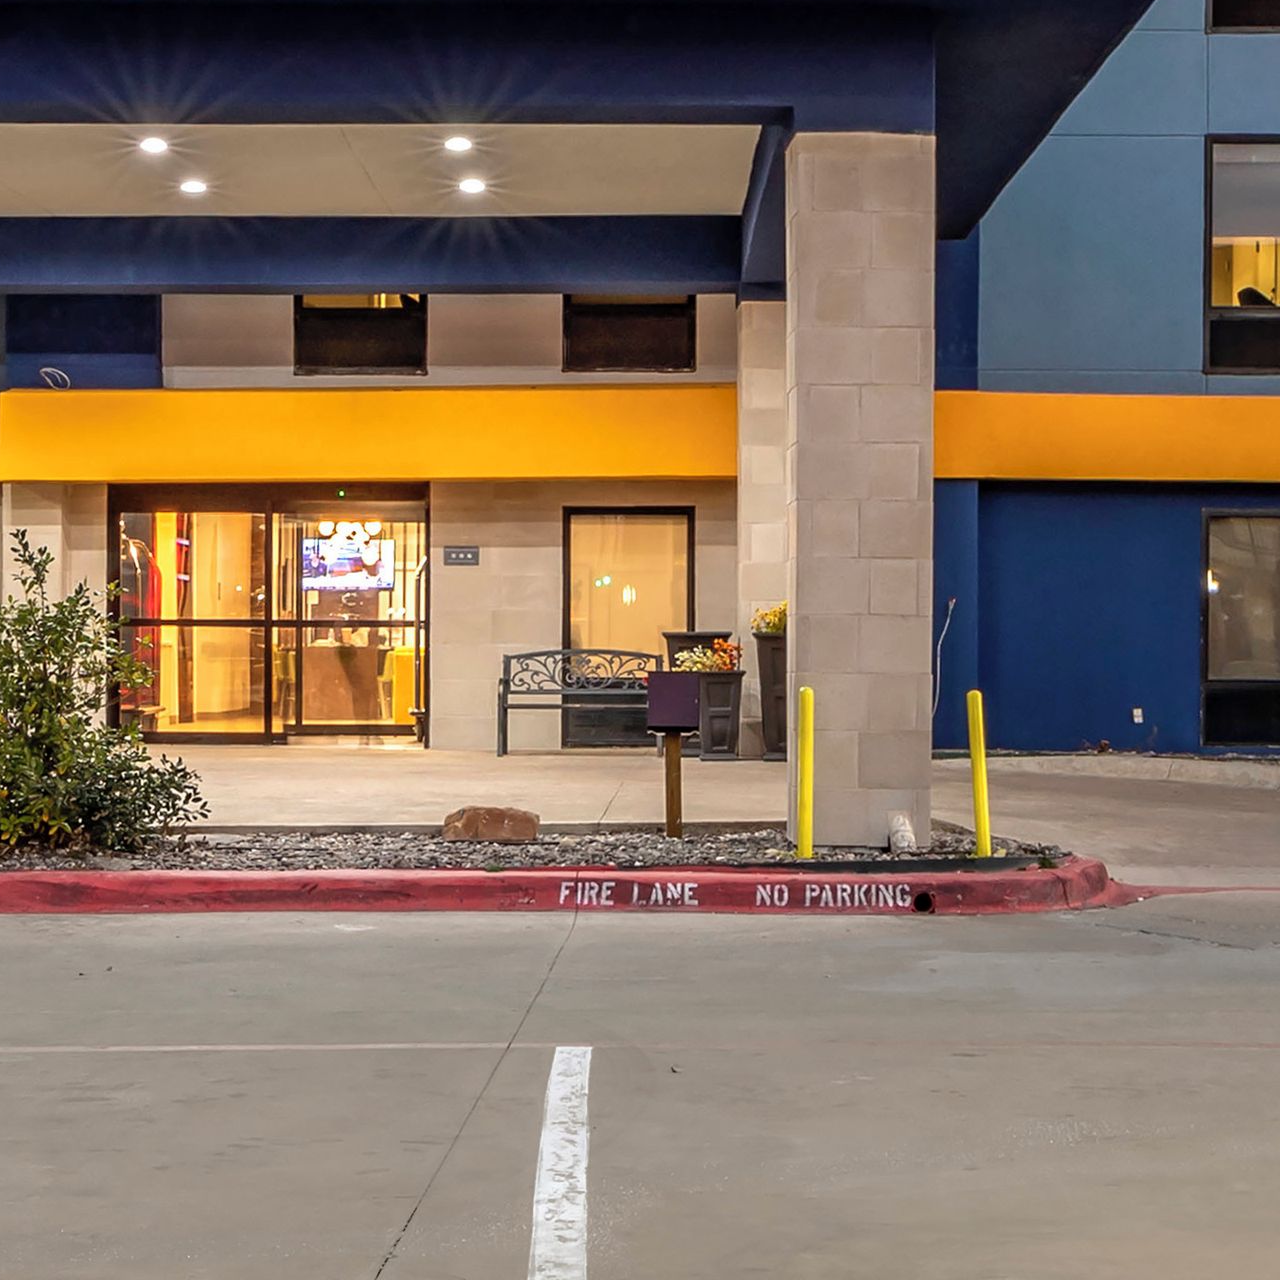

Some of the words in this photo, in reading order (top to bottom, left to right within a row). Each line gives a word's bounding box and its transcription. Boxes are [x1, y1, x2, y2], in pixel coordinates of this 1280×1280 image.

[559, 881, 616, 906] FIRE
[632, 882, 698, 906] LANE
[755, 884, 789, 907] NO
[804, 884, 912, 908] PARKING
